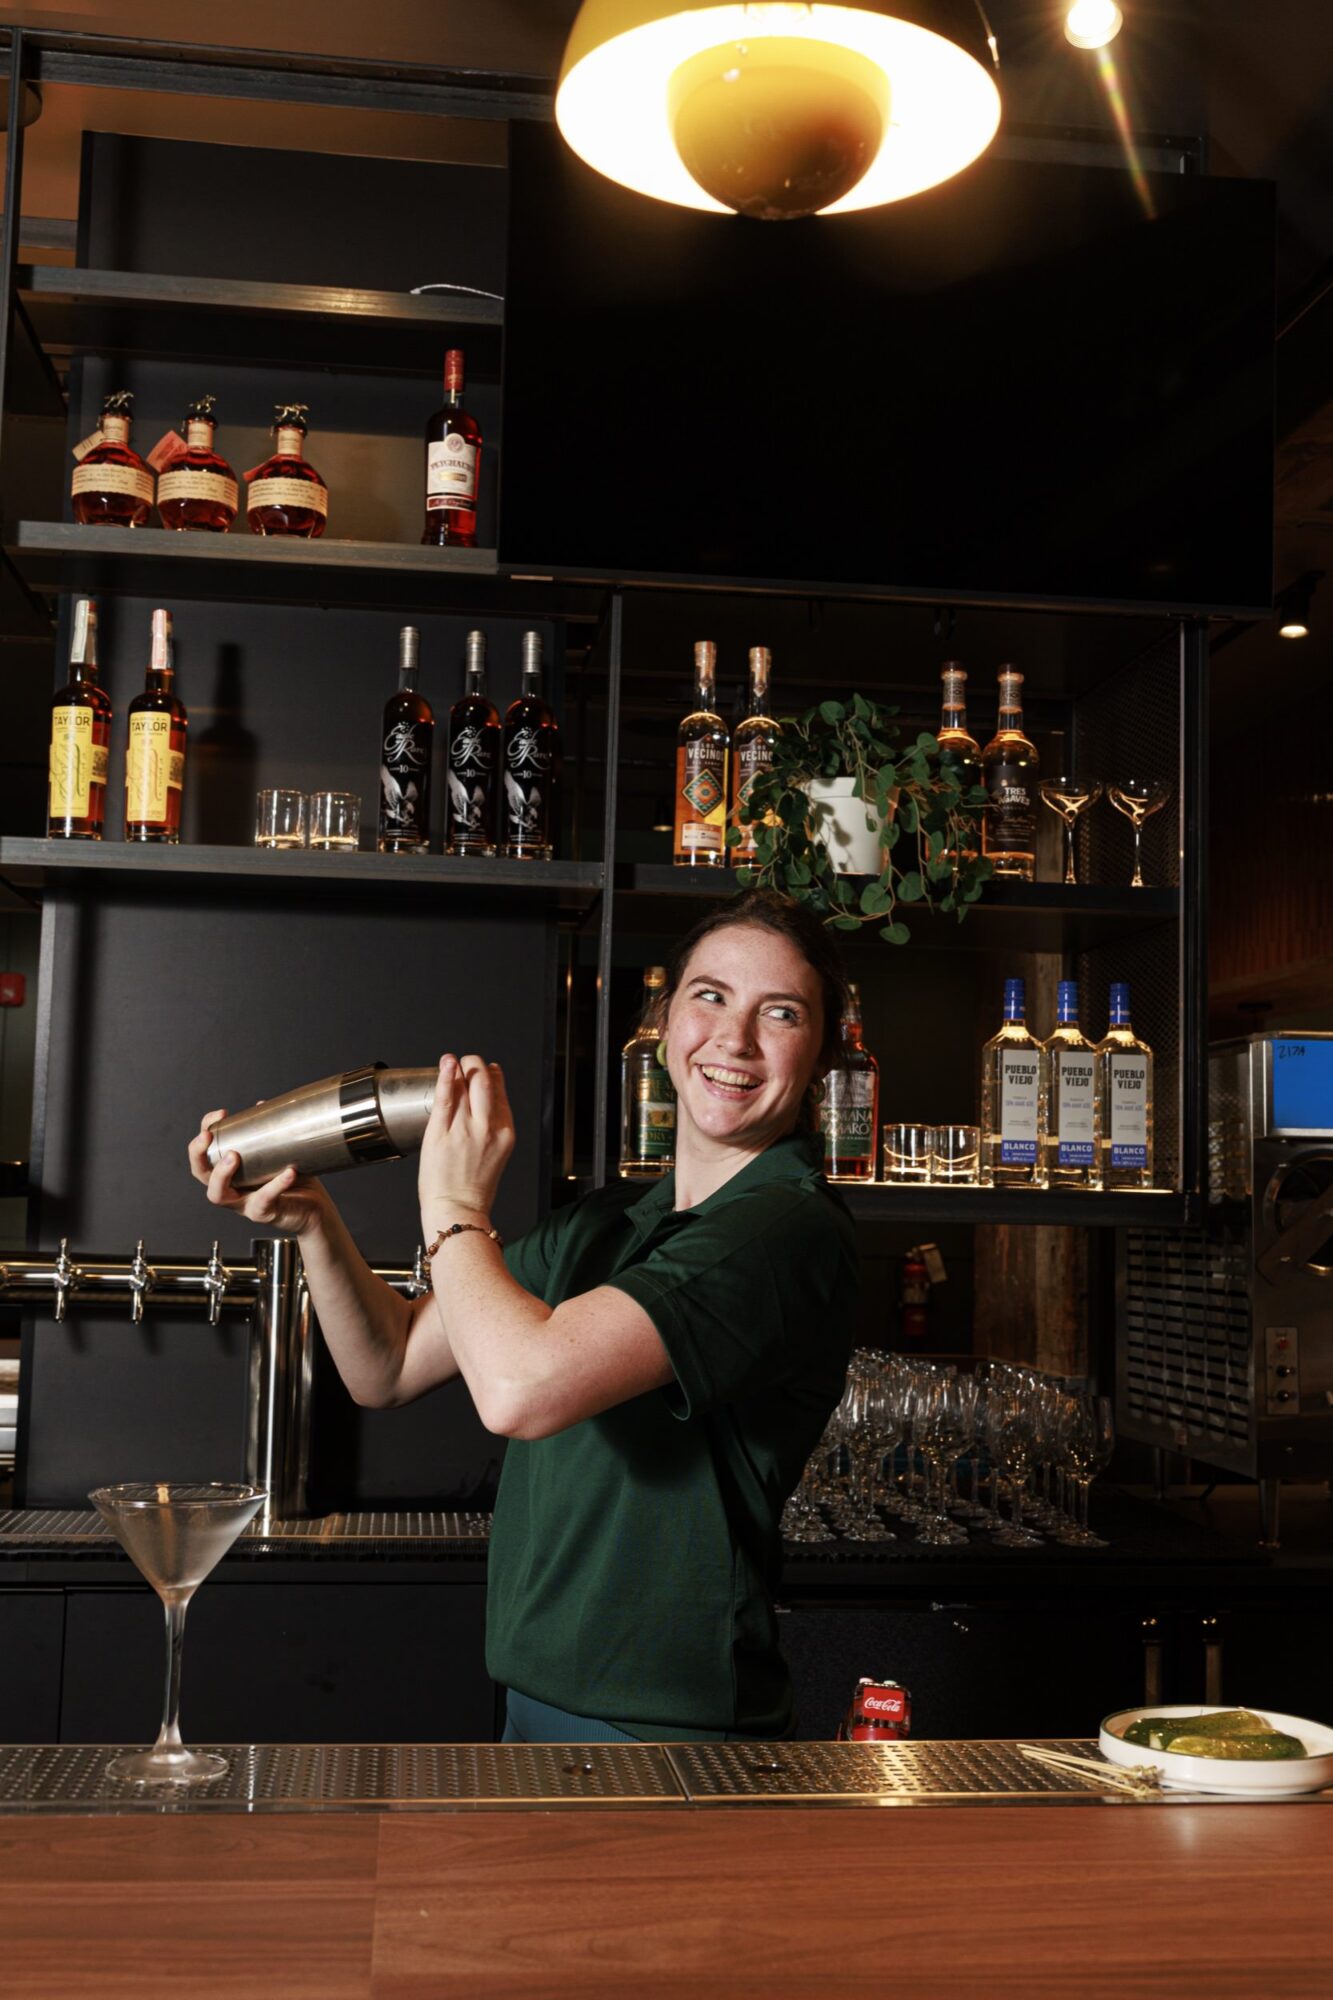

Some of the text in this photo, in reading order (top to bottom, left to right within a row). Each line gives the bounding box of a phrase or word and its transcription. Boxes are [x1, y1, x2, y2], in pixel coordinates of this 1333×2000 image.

[132, 721, 168, 732] TAYLOR
[399, 764, 409, 773] 10
[466, 769, 476, 778] 10
[523, 770, 532, 779] 10
[1005, 1065, 1037, 1075] PUEBLO
[1061, 1067, 1093, 1077] PUEBLO
[1113, 1069, 1145, 1079] PUEBLO
[1009, 1075, 1033, 1085] VIEJO
[1065, 1077, 1089, 1087] VIEJO
[1117, 1080, 1142, 1089] VIEJO
[1061, 1144, 1092, 1152] BLANCO
[1113, 1147, 1145, 1155] BLANCO
[864, 1696, 902, 1712] Coca-Cola
